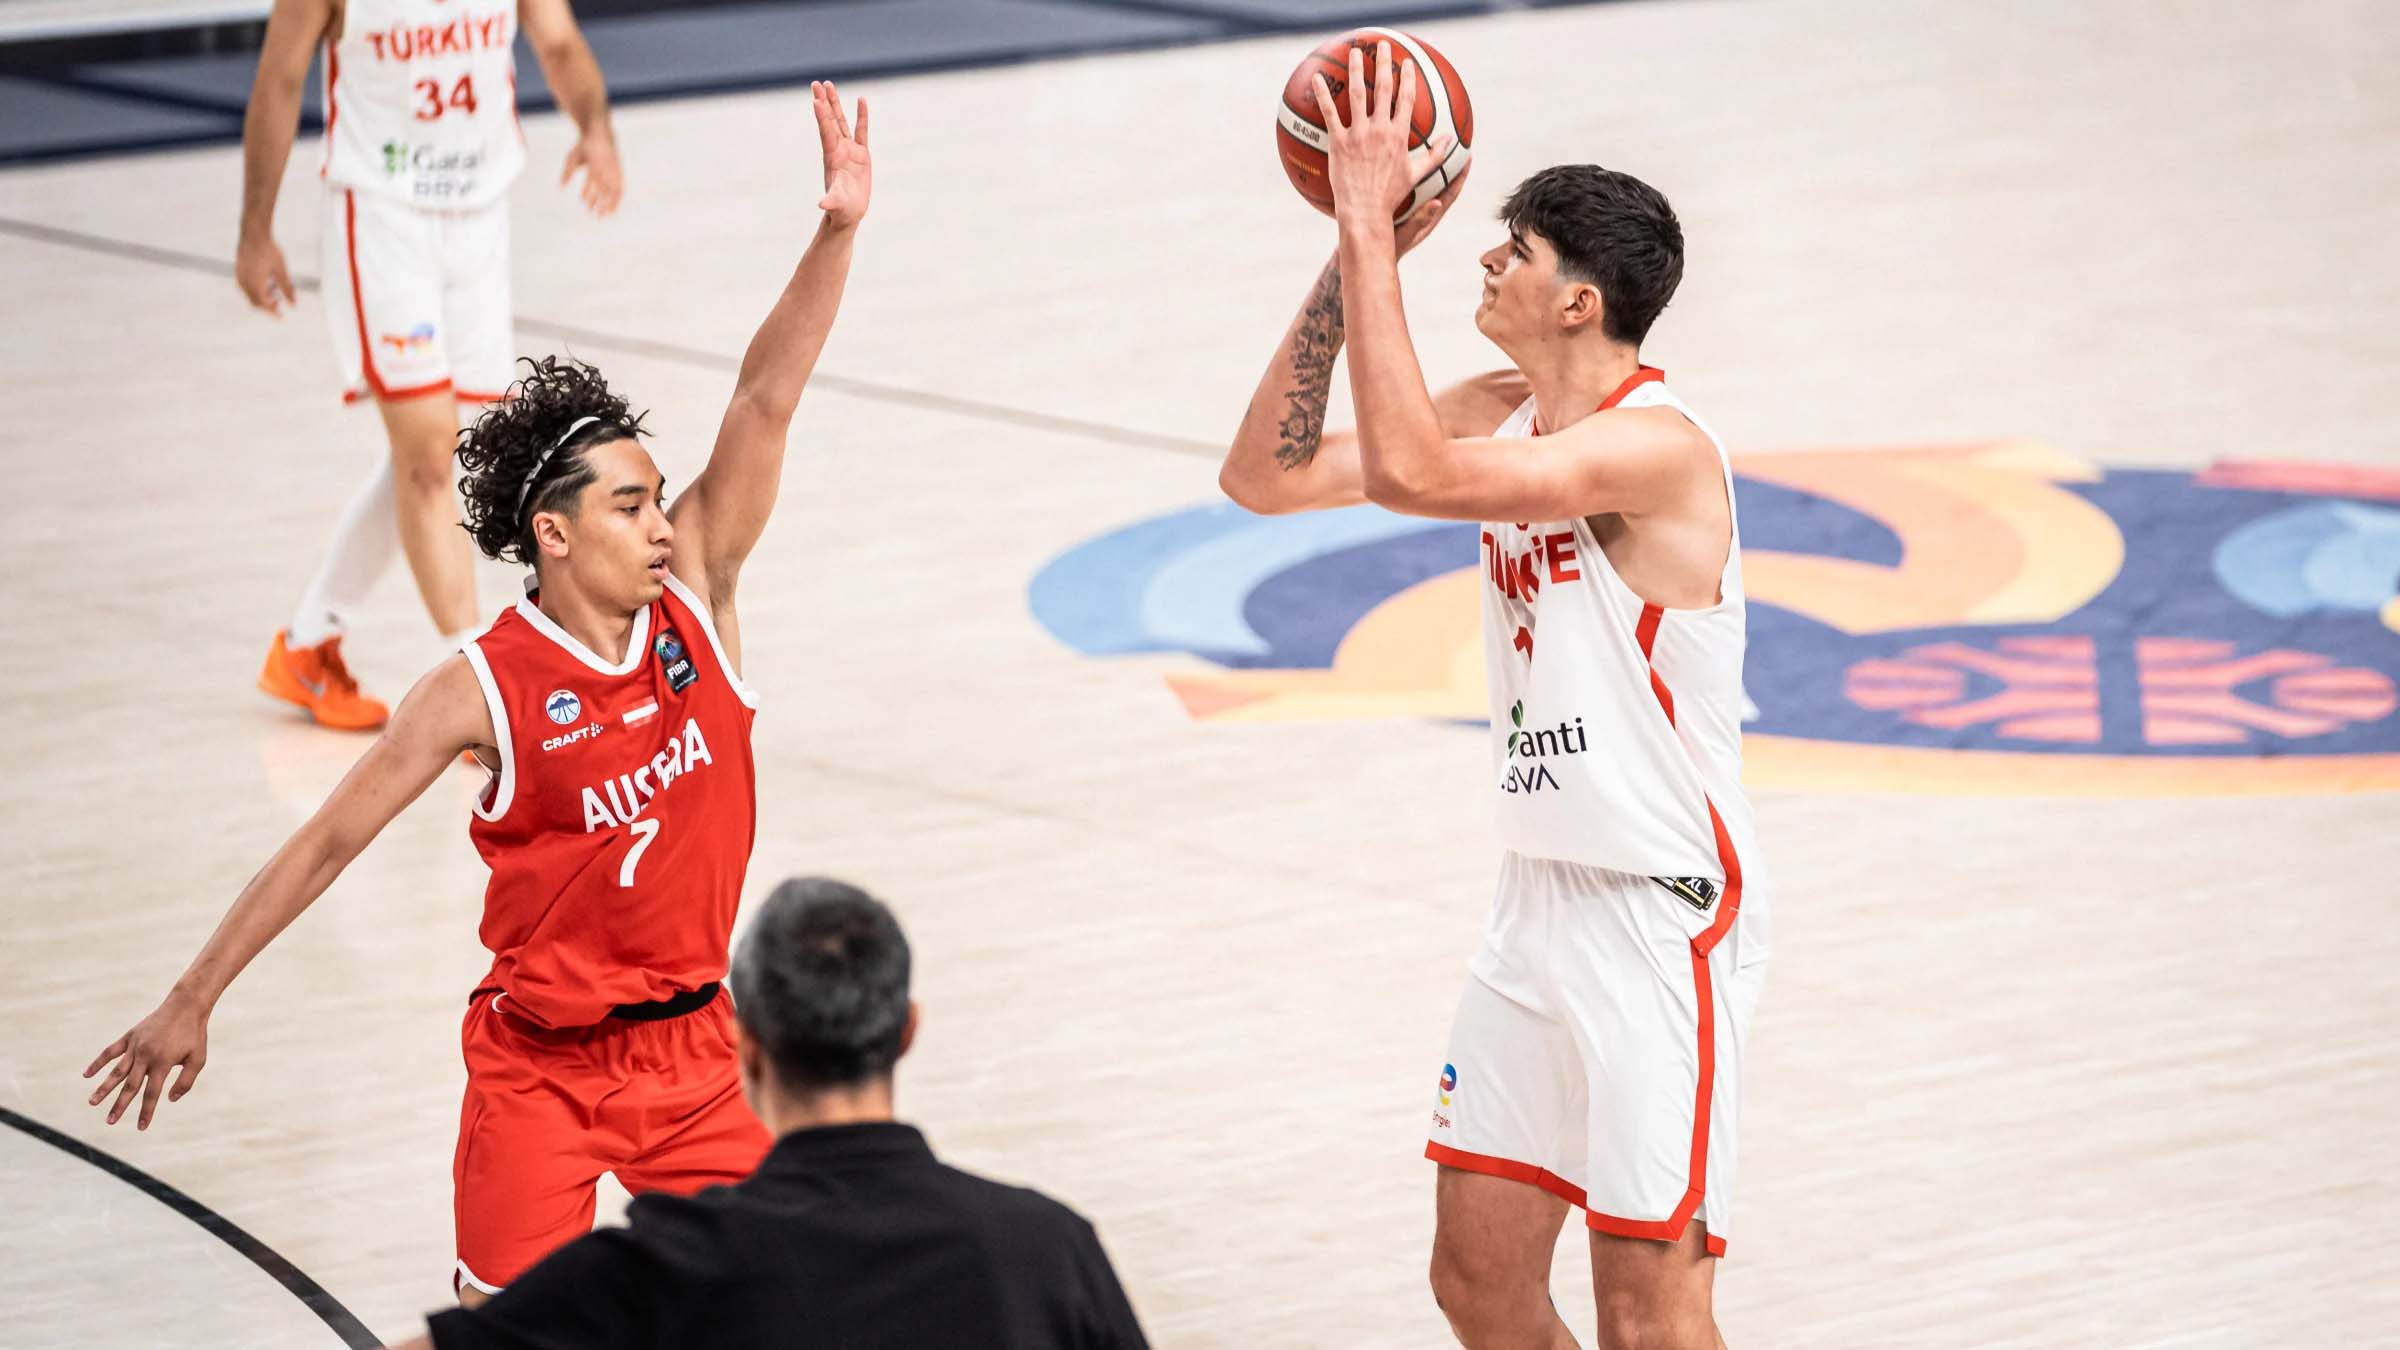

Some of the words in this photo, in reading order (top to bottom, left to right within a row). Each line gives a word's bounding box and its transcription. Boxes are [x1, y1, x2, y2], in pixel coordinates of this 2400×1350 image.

[415, 73, 478, 122] 34
[667, 660, 689, 680] FIBA
[542, 726, 590, 752] CRAFT
[1501, 763, 1561, 794] BVA
[619, 818, 660, 888] 7
[1685, 878, 1702, 894] XL
